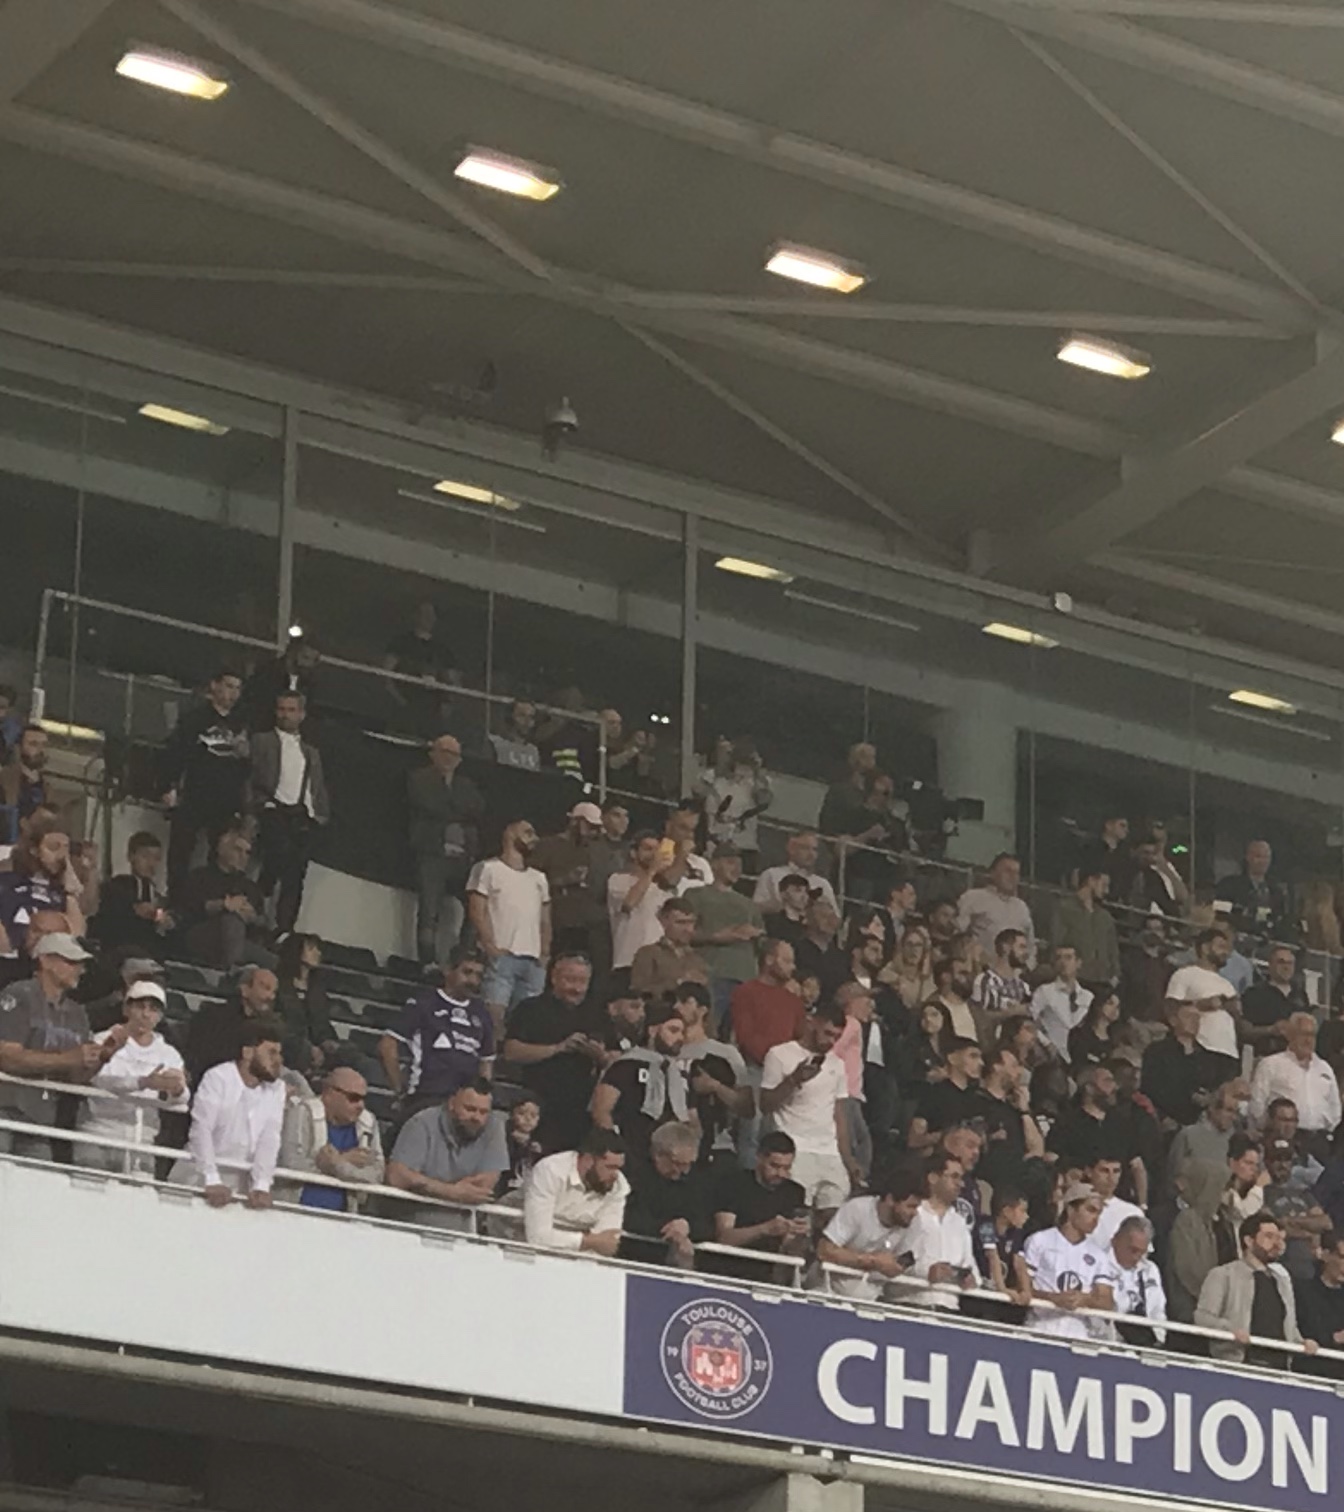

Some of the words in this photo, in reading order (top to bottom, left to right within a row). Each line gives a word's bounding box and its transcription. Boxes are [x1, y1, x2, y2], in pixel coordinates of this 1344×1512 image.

[681, 1305, 754, 1336] TOULOUSE
[673, 1371, 731, 1412] FOOTBALL
[731, 1383, 759, 1409] CLUB
[816, 1338, 1328, 1494] CHAMPION
